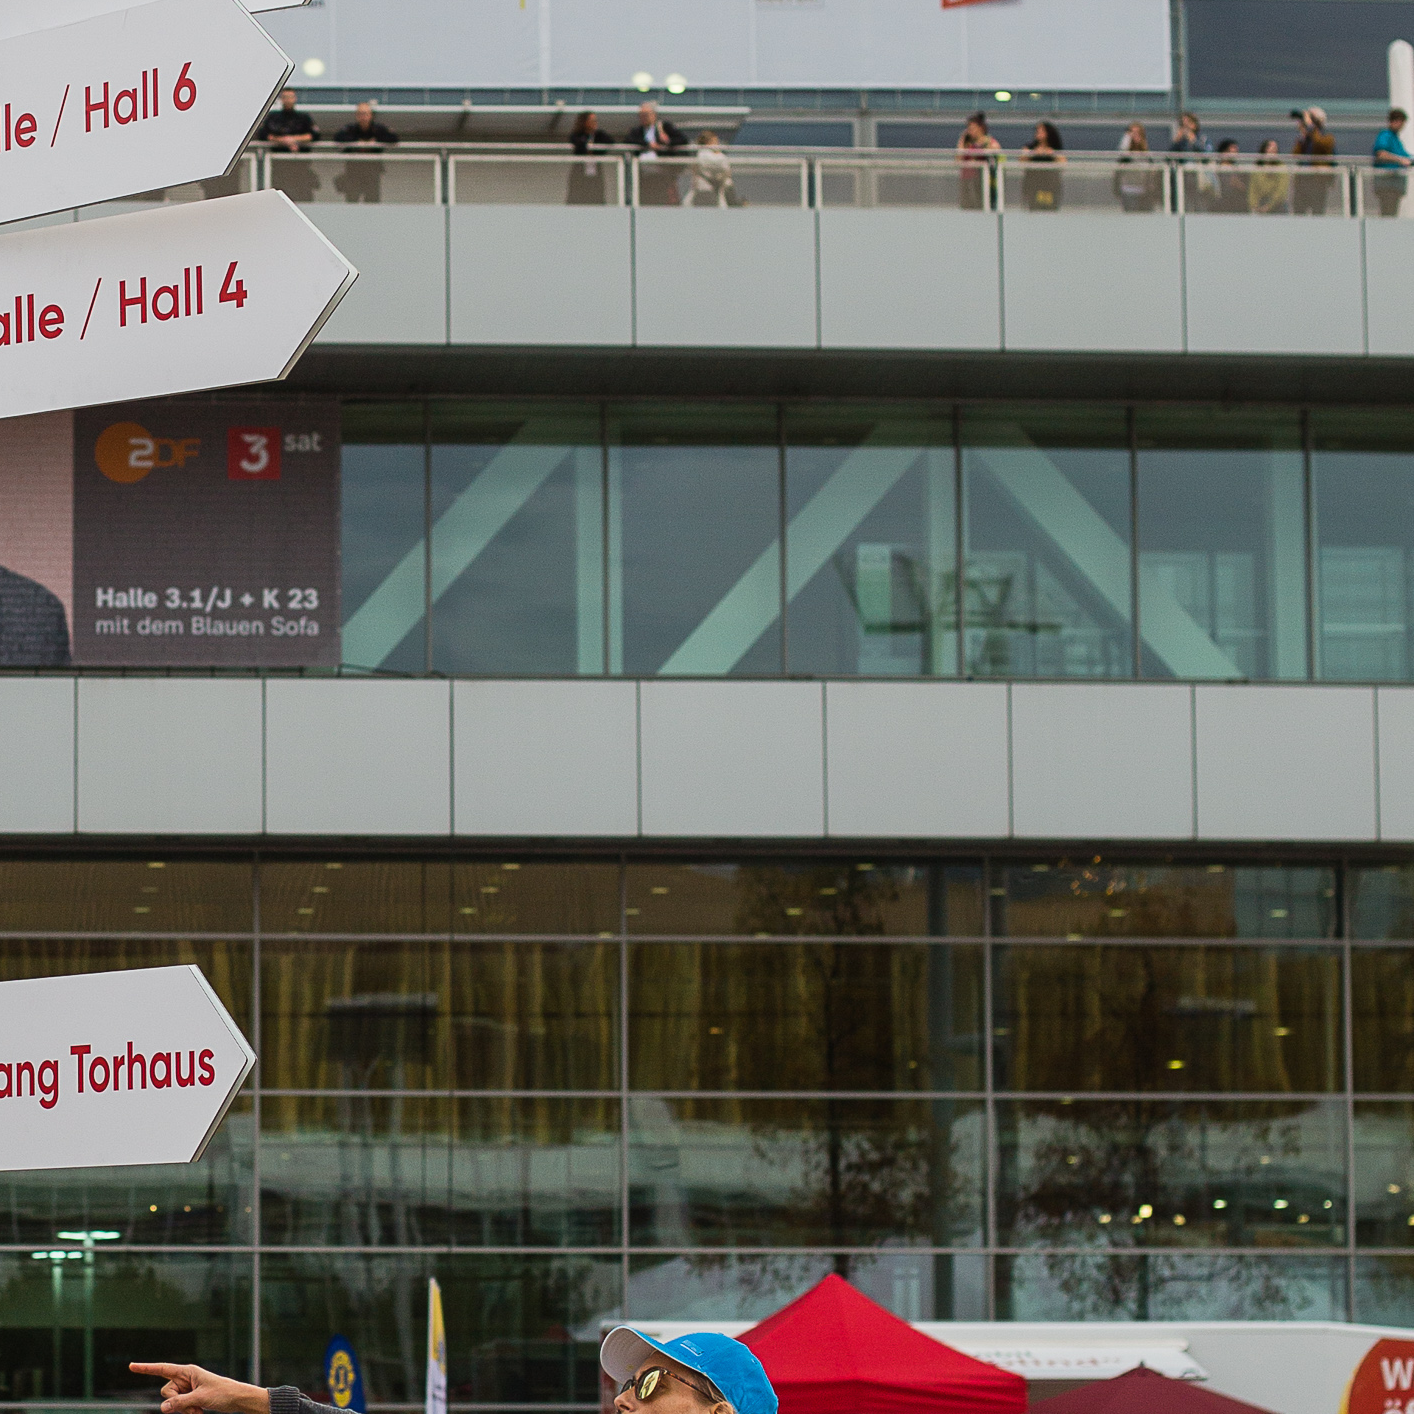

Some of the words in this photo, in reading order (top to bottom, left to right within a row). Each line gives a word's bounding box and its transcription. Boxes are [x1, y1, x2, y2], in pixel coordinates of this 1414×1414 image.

[50, 84, 70, 148] /
[84, 67, 159, 134] Hall
[172, 61, 198, 113] 6
[80, 278, 102, 340] /
[118, 265, 204, 329] Hall
[218, 260, 248, 310] 4
[95, 587, 158, 609] Halle
[164, 586, 233, 613] 3.1/J
[240, 593, 255, 607] +
[262, 588, 280, 609] K
[288, 588, 319, 609] 23
[95, 615, 130, 635] mit
[136, 615, 184, 635] dem
[191, 615, 264, 636] Blauen
[271, 615, 319, 636] Sofa
[69, 1040, 216, 1094] Torhaus
